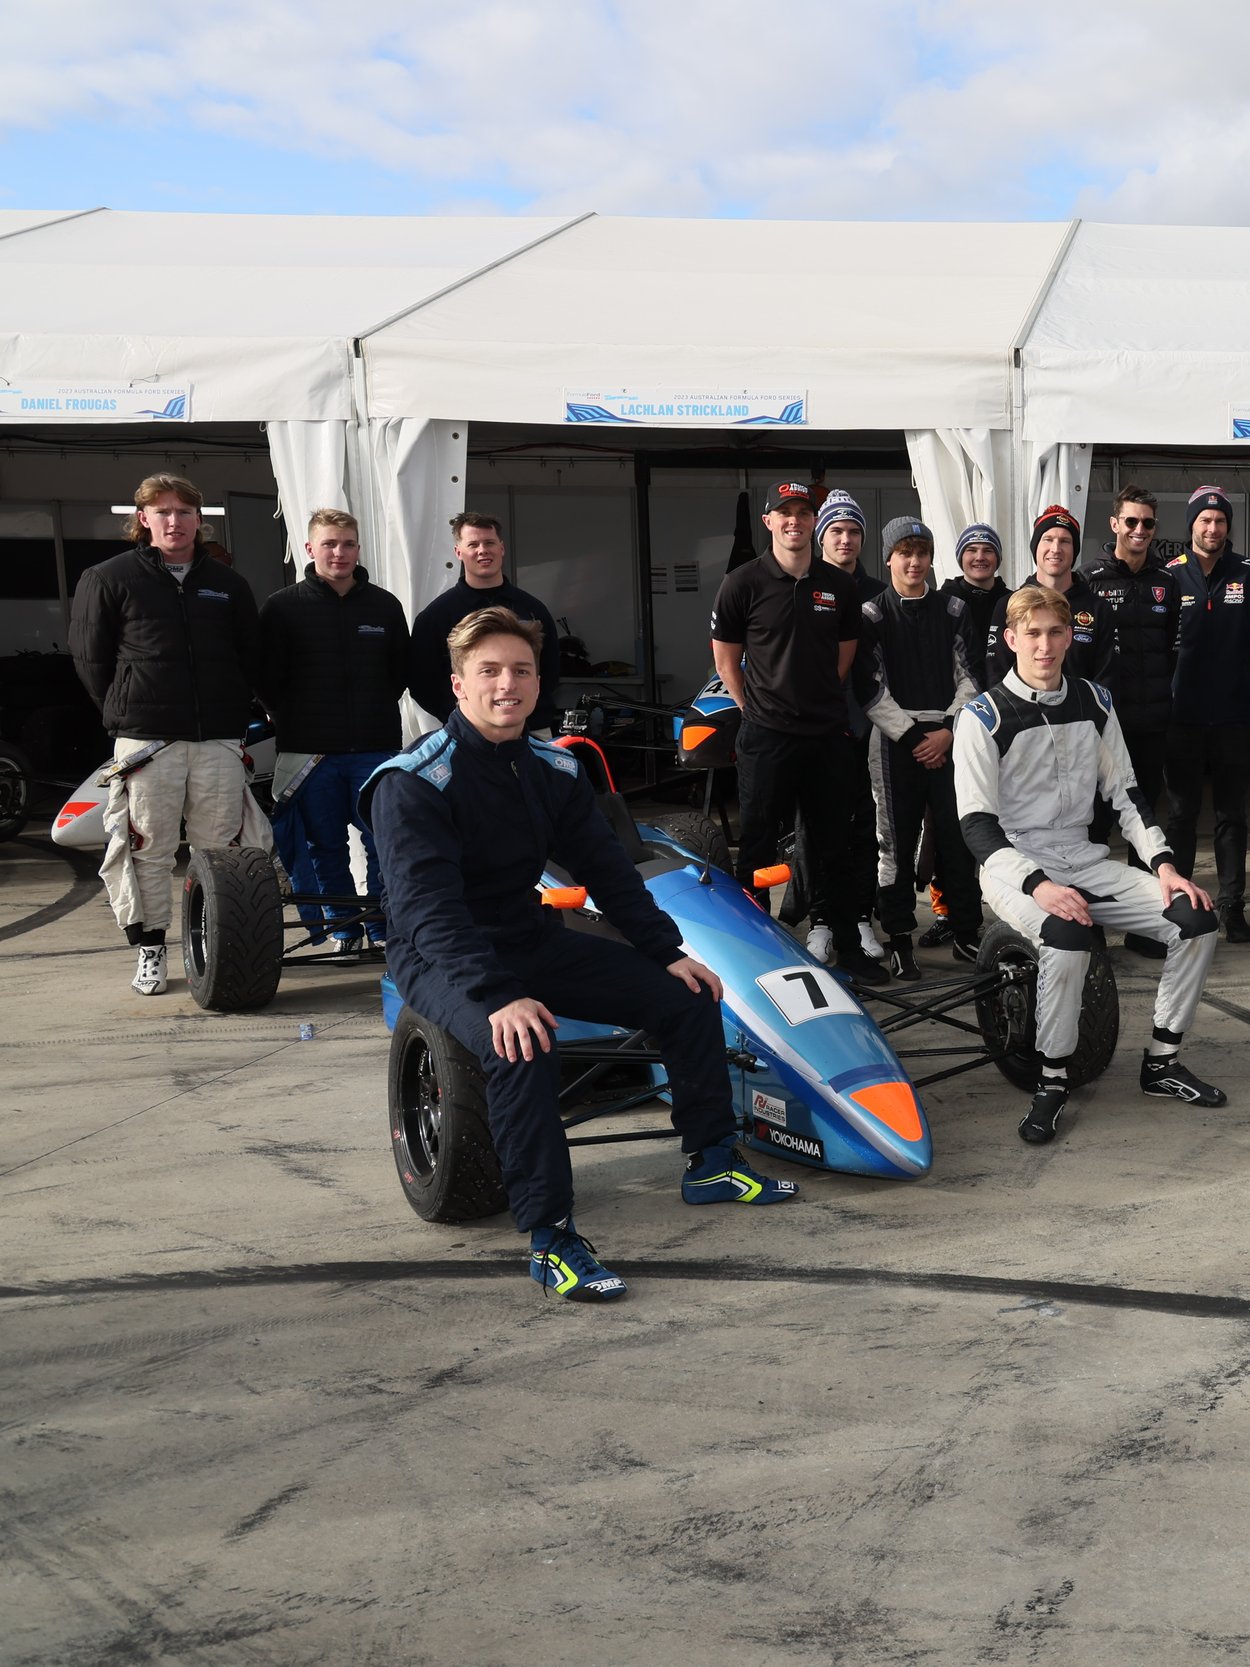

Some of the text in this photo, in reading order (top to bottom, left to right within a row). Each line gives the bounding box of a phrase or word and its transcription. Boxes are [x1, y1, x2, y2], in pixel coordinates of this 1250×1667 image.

[21, 398, 117, 410] DANIEL FROUGAS
[621, 404, 749, 416] LACHLAN STRICKLAND
[705, 681, 730, 694] 4
[555, 758, 576, 770] OMP
[430, 765, 449, 781] OMP
[782, 971, 829, 1010] 7
[766, 1105, 785, 1116] RACER
[769, 1128, 821, 1158] YOKOHAMA
[589, 1279, 622, 1291] OMP
